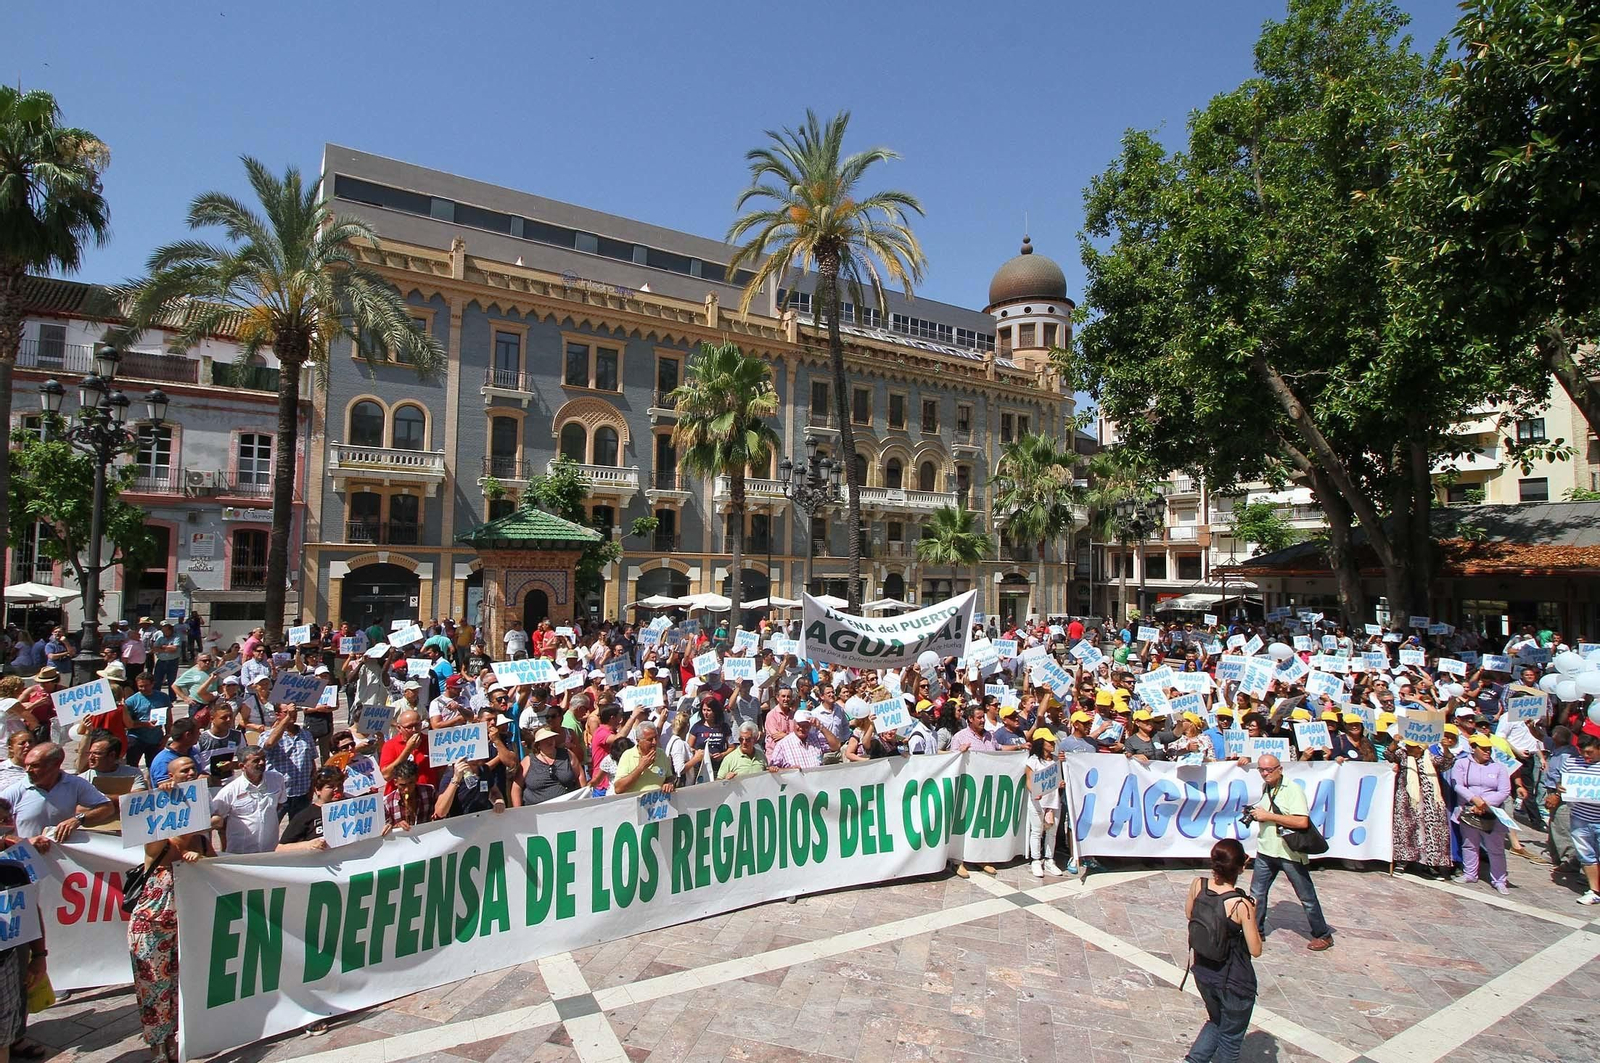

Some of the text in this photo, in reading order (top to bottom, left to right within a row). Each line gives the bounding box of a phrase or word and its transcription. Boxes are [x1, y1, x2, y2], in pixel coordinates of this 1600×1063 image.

[825, 605, 959, 633] LUENA del PUERTO
[806, 619, 905, 657] AGUA
[498, 660, 550, 674] ¡¡AGUA
[280, 674, 321, 691] ¡¡AGUA
[516, 670, 547, 683] YA!!
[59, 683, 103, 706] ¡¡AGUA
[283, 688, 311, 703] YA!!
[72, 700, 101, 717] YA!!
[364, 706, 391, 718] ¡¡AGUA
[873, 700, 902, 715] ¡¡AGUA
[1518, 707, 1539, 717] YA!!
[366, 719, 385, 731] YA!!
[882, 712, 902, 727] YA!!
[434, 726, 480, 746] ¡¡AGUA
[1308, 735, 1326, 746] YA!!
[445, 743, 476, 762] YA!!
[348, 760, 375, 778] AGUA
[1034, 764, 1058, 783] ¡¡AGUA
[1041, 776, 1057, 793] YA!!
[129, 784, 198, 816] ¡¡AGUA
[329, 797, 377, 823] ¡¡AGUA
[647, 804, 669, 821] YA!!
[146, 808, 191, 835] YA!!
[341, 816, 373, 839] YA!!
[207, 886, 287, 1009] EN
[302, 840, 511, 984] DEFENSA
[525, 829, 578, 927] DE
[591, 821, 660, 914] LOS
[670, 783, 829, 895] REGADÍOS
[839, 784, 895, 859] DEL
